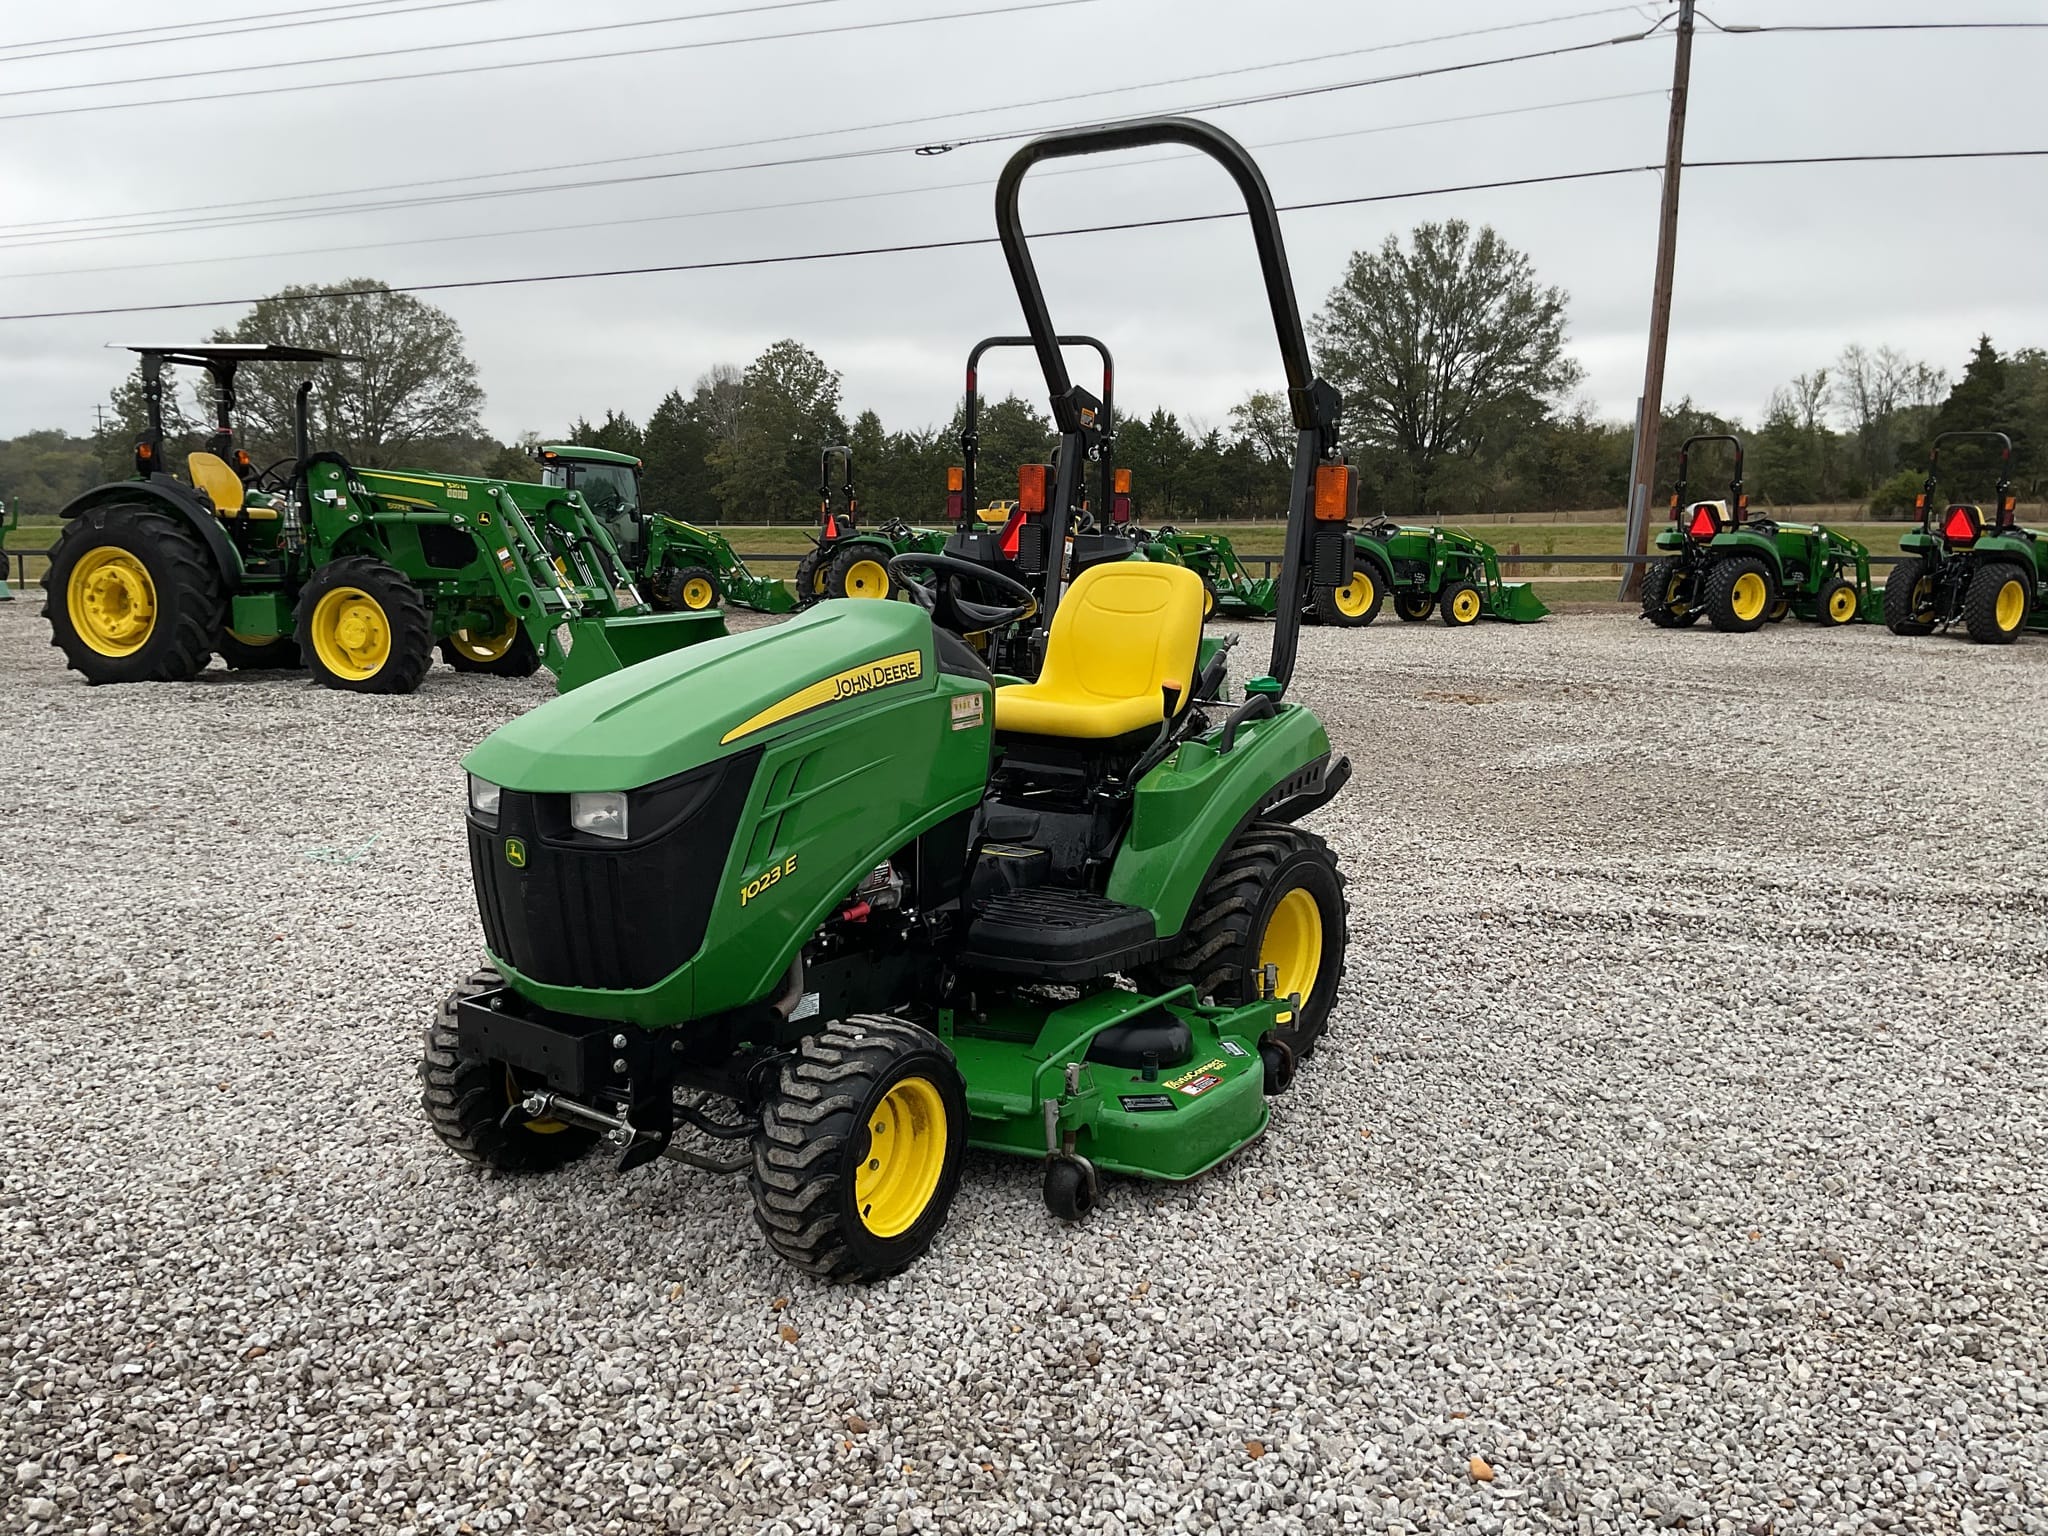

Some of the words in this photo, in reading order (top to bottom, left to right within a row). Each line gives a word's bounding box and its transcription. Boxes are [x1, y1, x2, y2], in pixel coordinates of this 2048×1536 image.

[833, 672, 872, 698] JOHN
[872, 661, 917, 685] DEERE
[740, 865, 782, 907] 1023
[784, 853, 798, 876] E
[1167, 1058, 1224, 1090] AutoConnect
